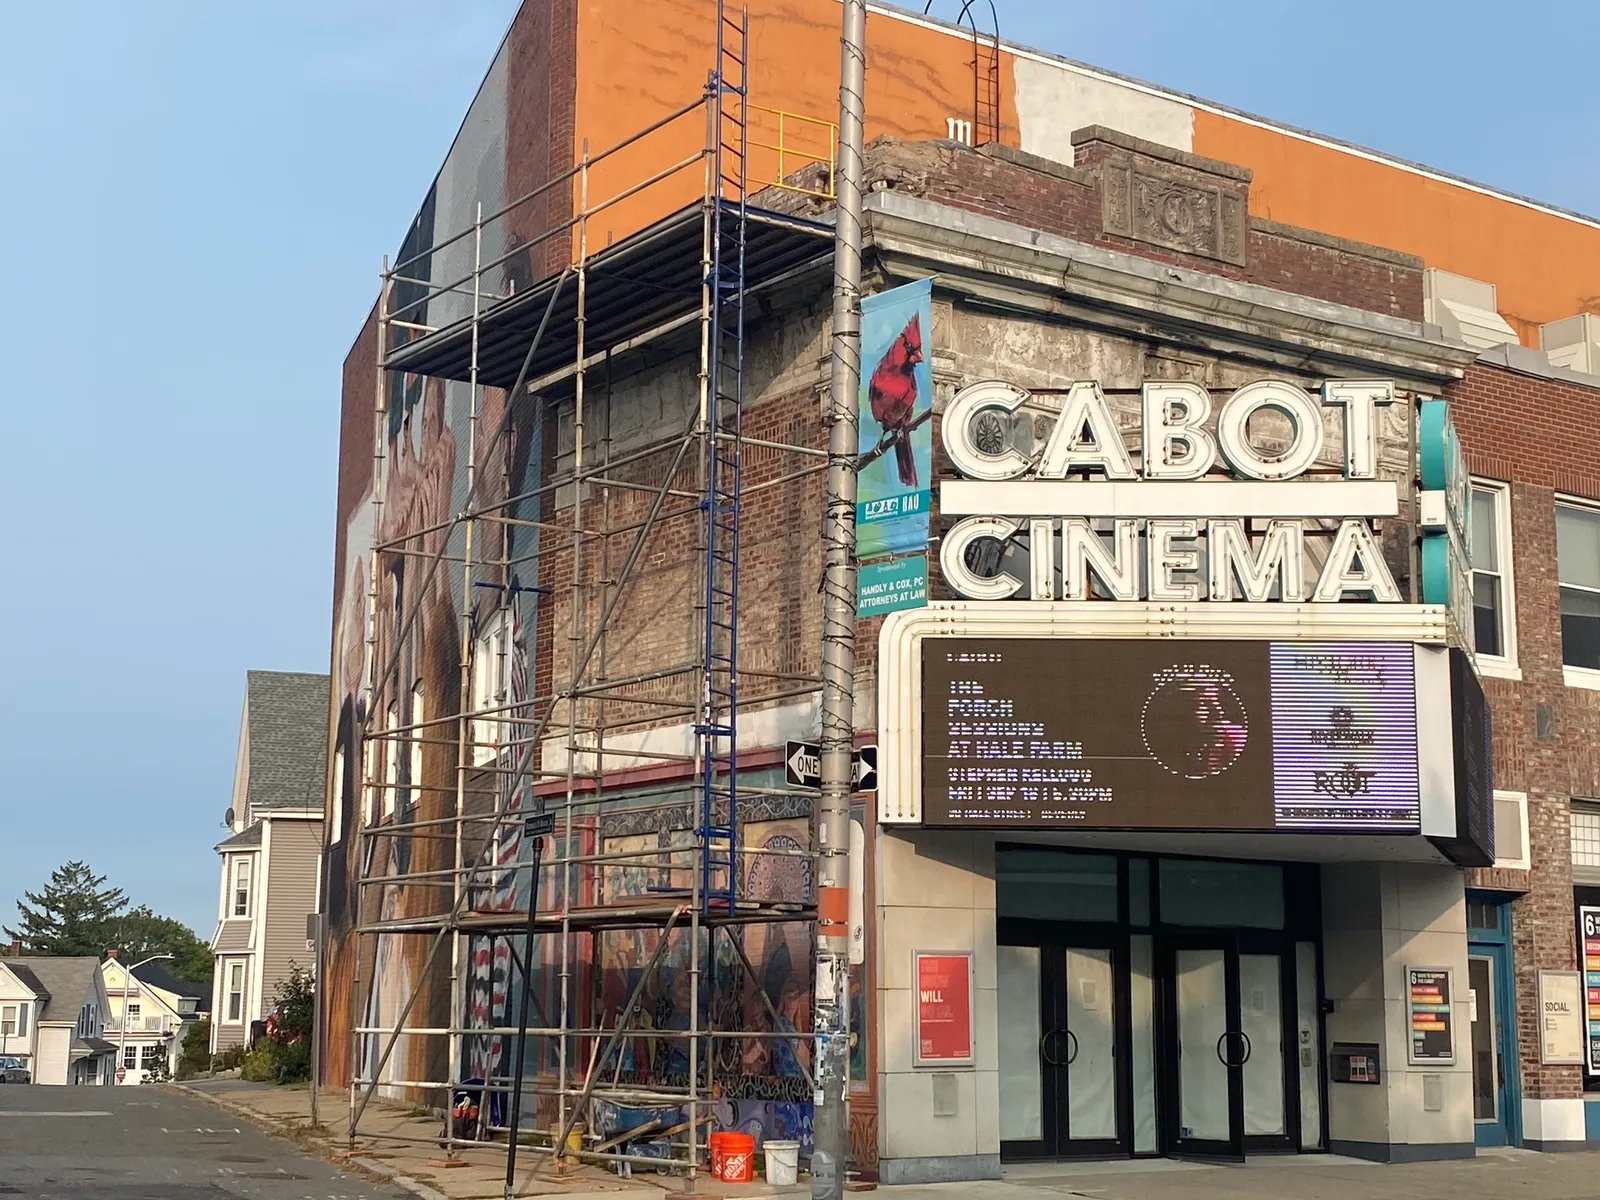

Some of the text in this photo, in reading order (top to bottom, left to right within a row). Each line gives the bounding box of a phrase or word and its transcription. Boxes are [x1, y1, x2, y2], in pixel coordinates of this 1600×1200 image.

[941, 378, 1394, 481] CABOT
[939, 514, 1403, 602] CINEMA
[861, 577, 924, 596] HANDLY & COX, PC
[859, 589, 926, 609] ATTORNEYS AT LAW
[948, 699, 1014, 717] PORCH
[948, 740, 972, 758] AT
[1030, 741, 1082, 759] FARM
[797, 756, 819, 775] ONE
[1585, 914, 1595, 936] 6
[1411, 972, 1417, 985] 6
[920, 990, 944, 1003] WILL
